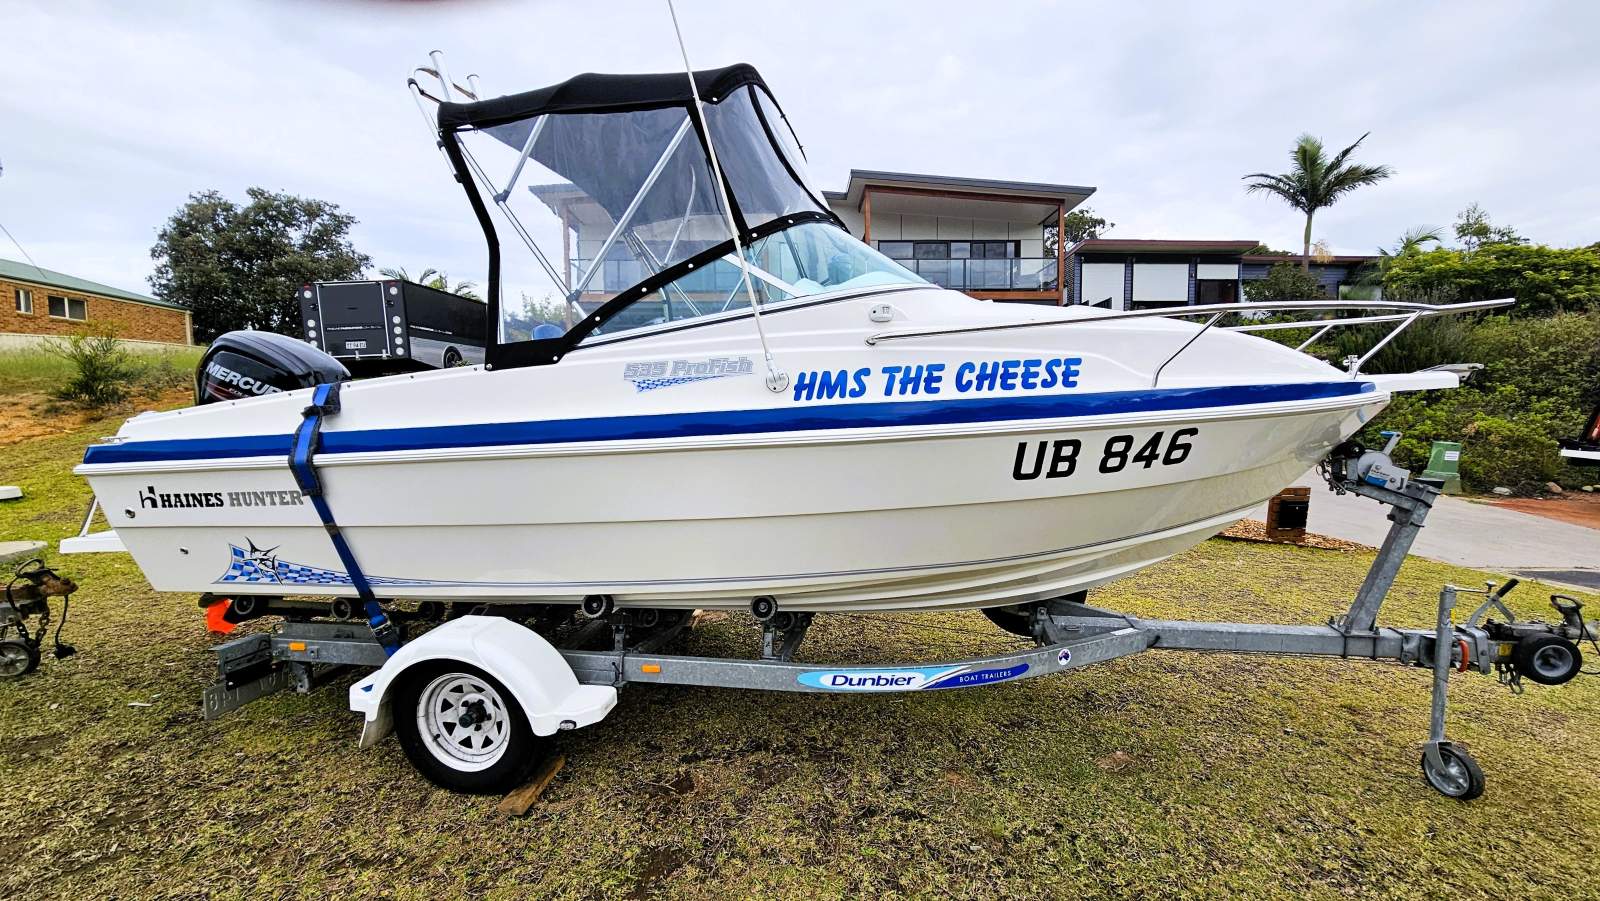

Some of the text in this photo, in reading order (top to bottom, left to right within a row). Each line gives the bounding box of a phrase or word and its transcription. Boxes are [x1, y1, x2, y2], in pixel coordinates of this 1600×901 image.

[670, 356, 754, 378] ProFish
[206, 361, 284, 396] MERCUR
[793, 357, 1082, 401] HMS THE CHEESE
[1012, 427, 1199, 480] UB 846
[159, 490, 304, 508] HAINES HUNTER
[831, 674, 916, 687] Dunbier
[959, 670, 1013, 683] BOAT TRAILERS
